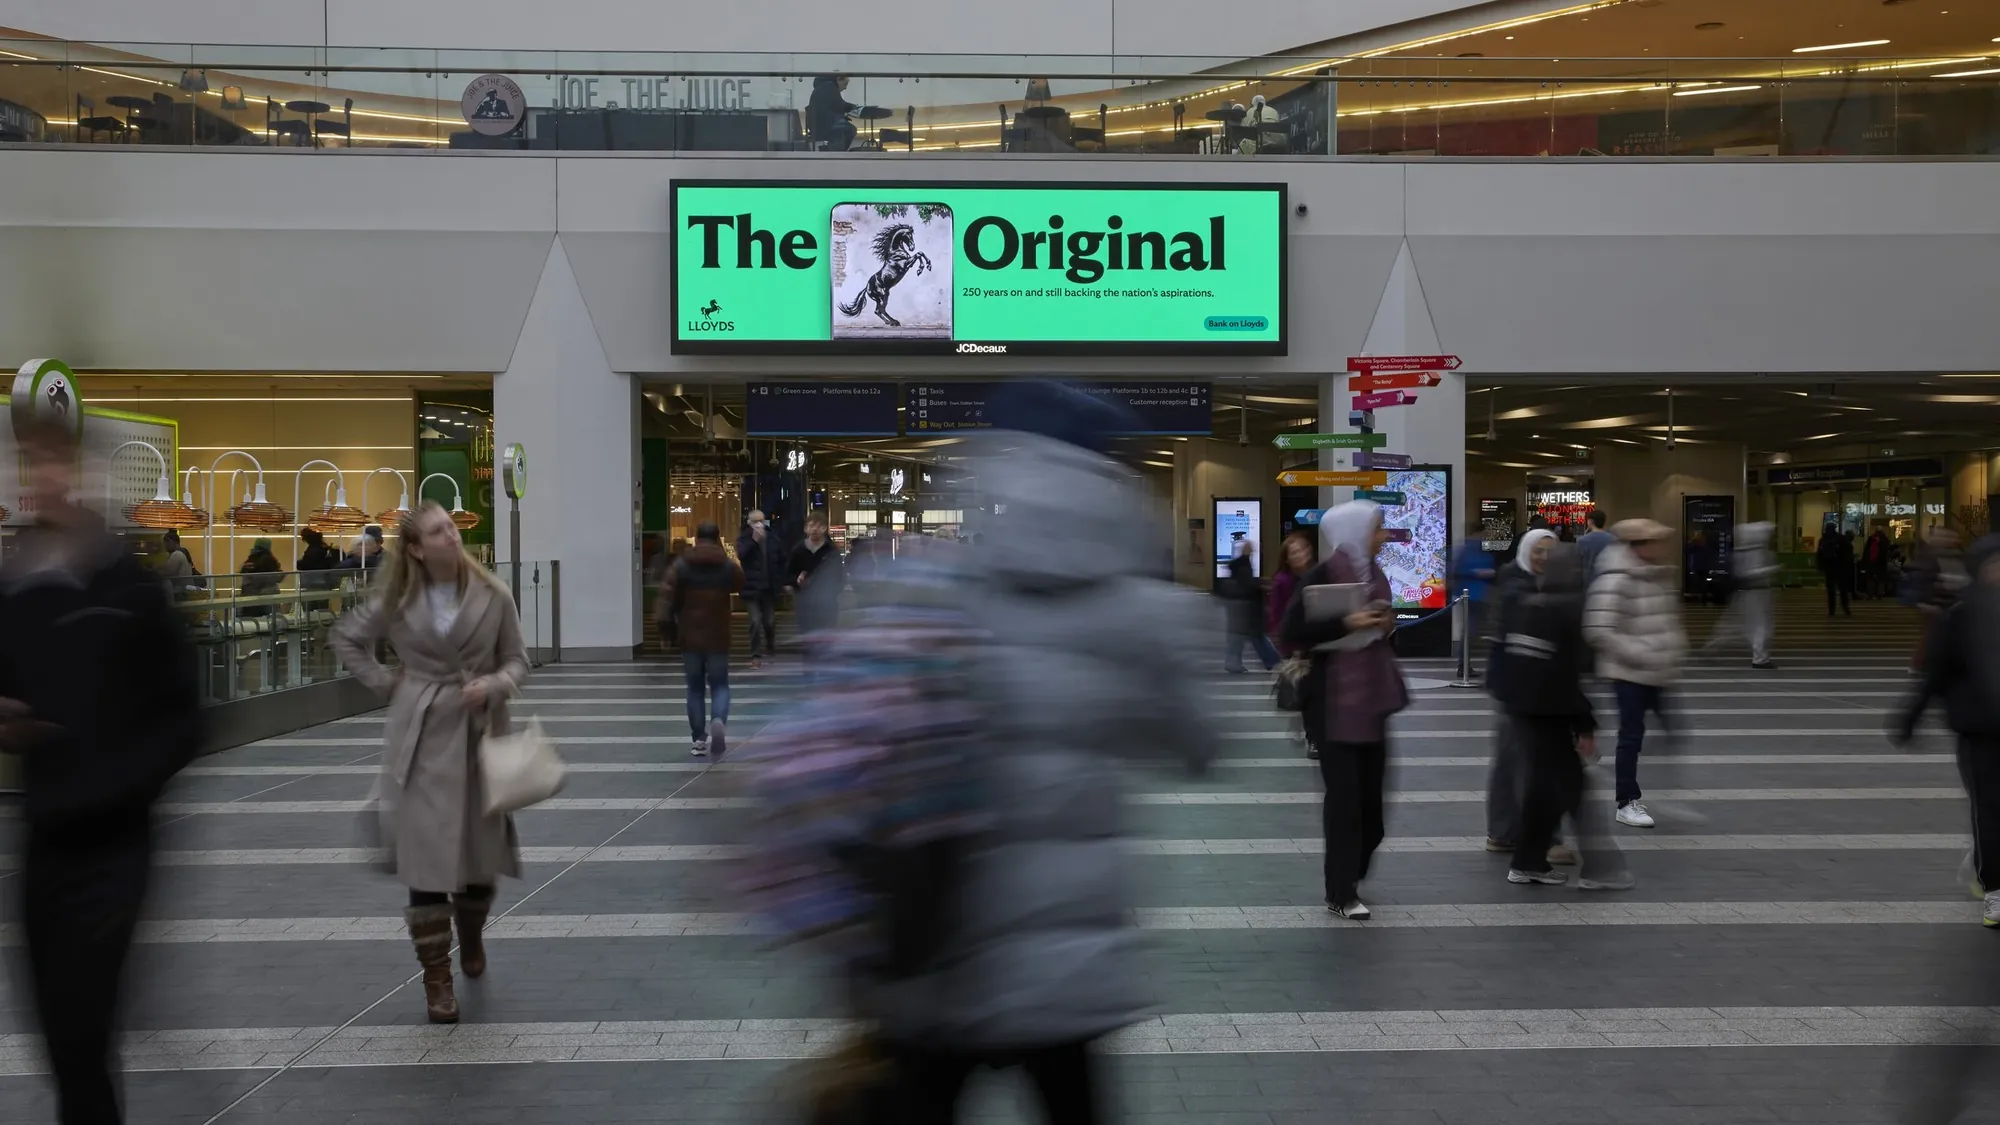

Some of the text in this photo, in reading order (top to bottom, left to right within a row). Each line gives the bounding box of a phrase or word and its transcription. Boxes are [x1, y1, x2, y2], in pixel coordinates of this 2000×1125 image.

[467, 78, 520, 100] JOE & THE JUICE
[552, 77, 600, 111] JOE
[620, 77, 669, 111] THE
[678, 78, 752, 112] JUICE
[688, 213, 1227, 285] The Original
[962, 287, 981, 297] 250
[983, 289, 1009, 299] years
[1010, 289, 1023, 297] on
[1025, 287, 1043, 297] and
[1045, 287, 1062, 297] still
[1064, 287, 1102, 299] backing
[1103, 288, 1119, 297] the
[1160, 288, 1215, 299] aspirations.
[688, 321, 735, 332] LLOYDS
[1208, 320, 1228, 328] Bank
[1240, 320, 1264, 330] Lloyds
[956, 343, 1007, 353] JCDecaux
[782, 387, 800, 395] Green
[823, 387, 852, 395] Platforms
[852, 387, 862, 395] 6a
[869, 387, 881, 395] 12a
[1088, 387, 1110, 396] Lounge
[1159, 398, 1188, 406] reception
[929, 421, 943, 429] Way
[1788, 470, 1815, 480] Customer
[1541, 491, 1590, 503] WETHERS
